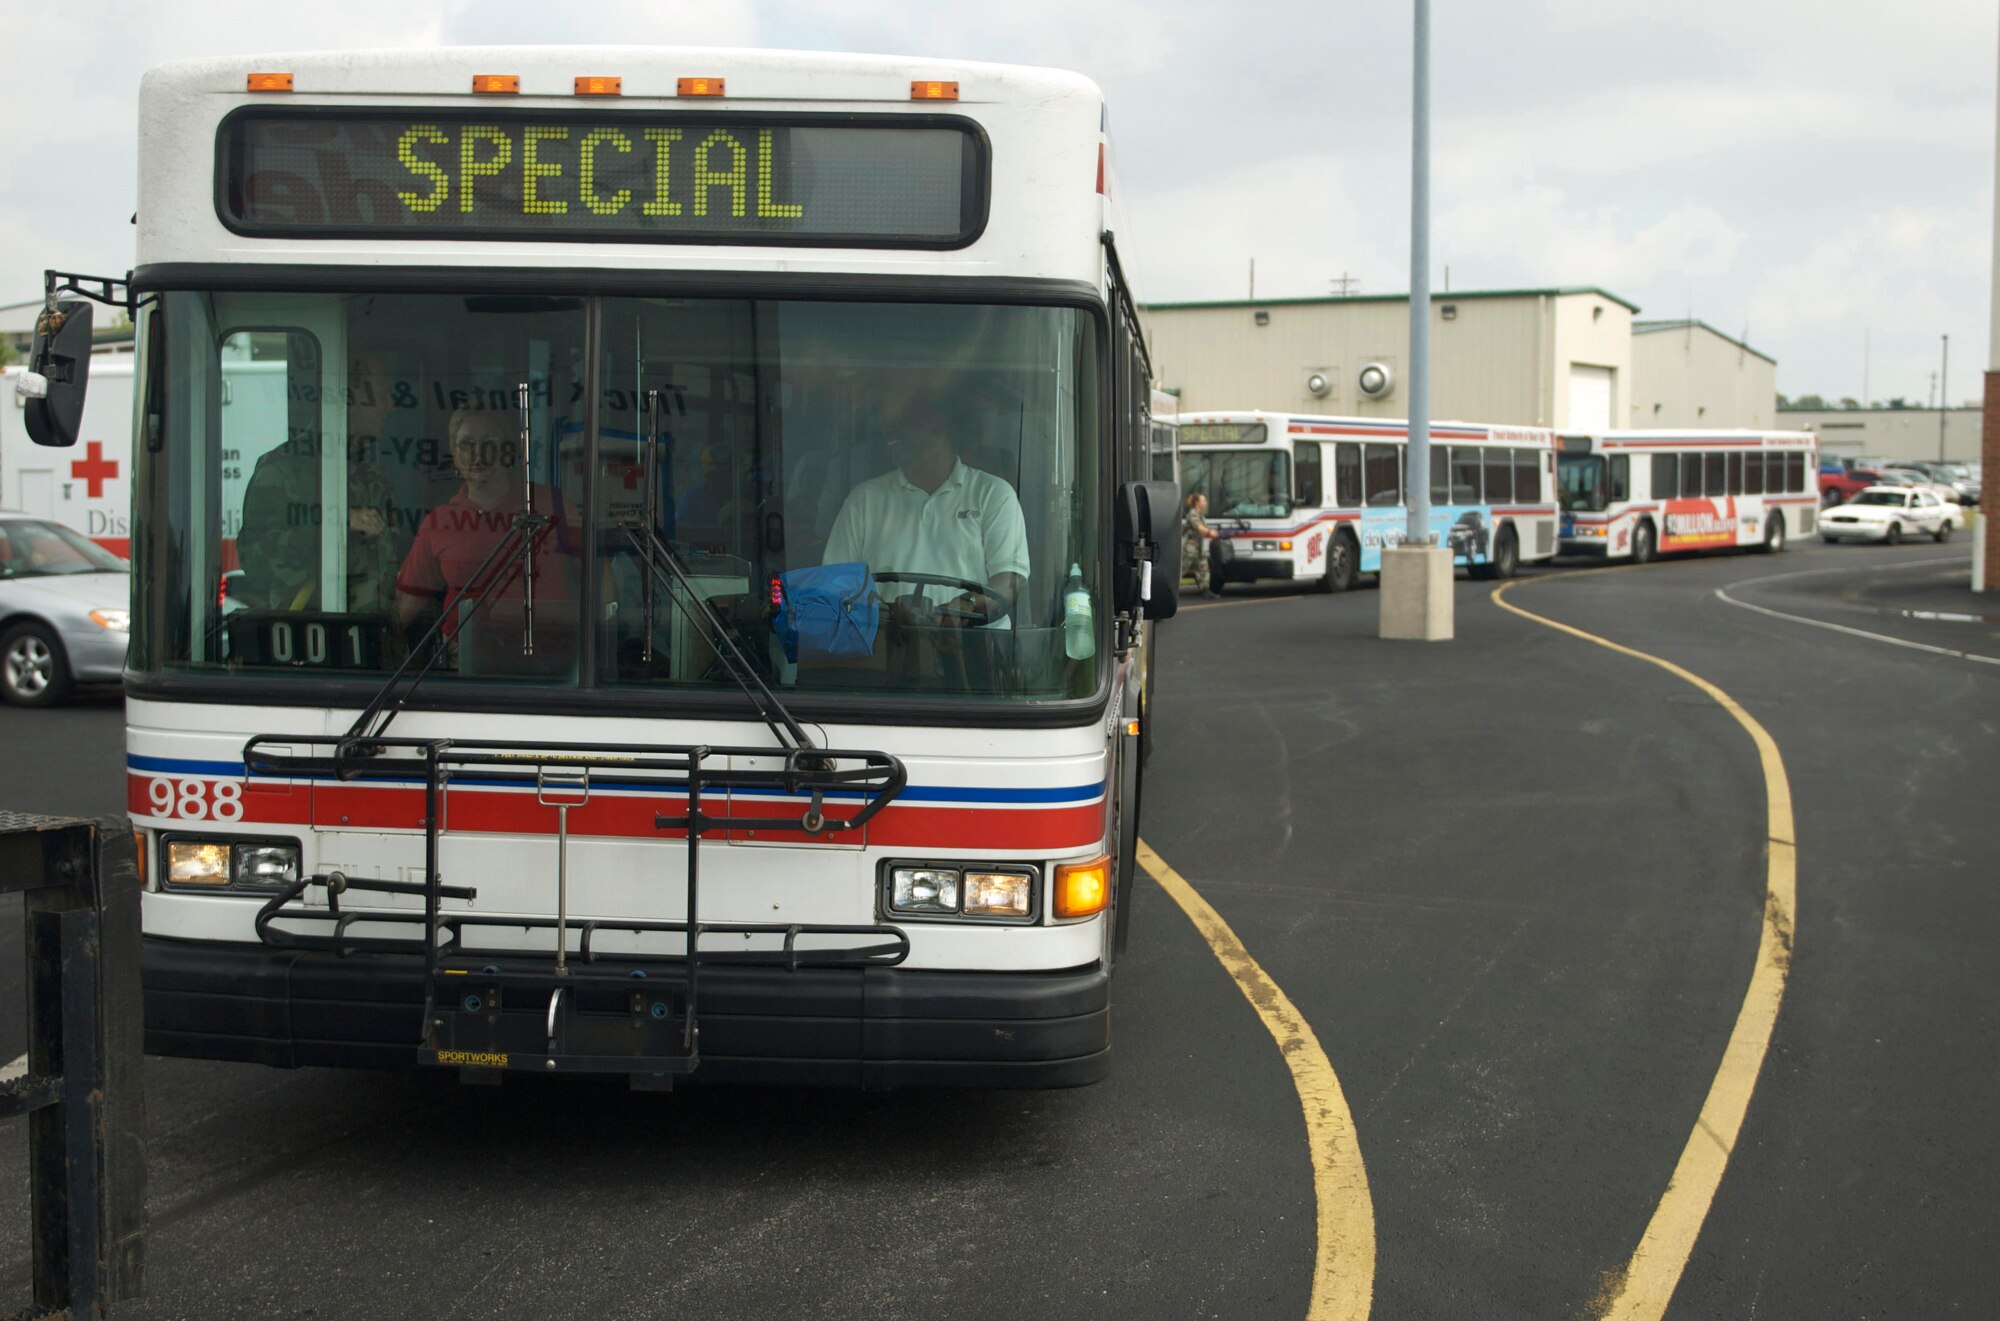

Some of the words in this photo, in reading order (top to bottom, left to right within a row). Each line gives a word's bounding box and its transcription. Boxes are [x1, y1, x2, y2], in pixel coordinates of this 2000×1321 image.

[397, 124, 803, 218] SPECIAL
[149, 777, 244, 822] 988
[437, 1050, 509, 1064] SPORTWORKS
